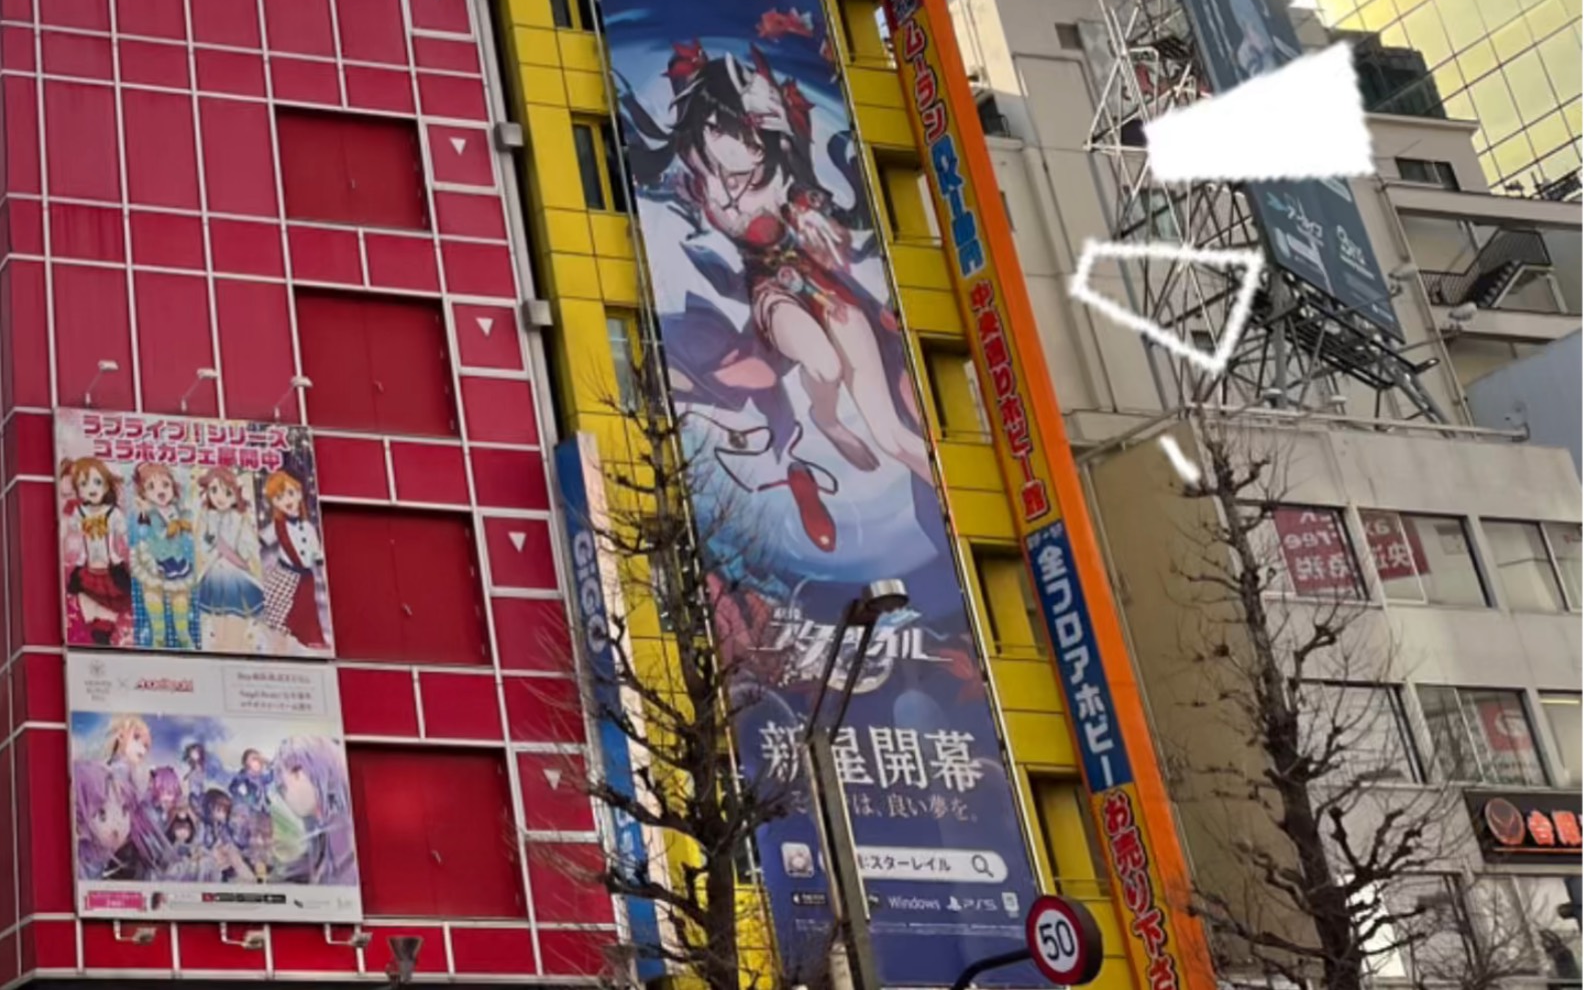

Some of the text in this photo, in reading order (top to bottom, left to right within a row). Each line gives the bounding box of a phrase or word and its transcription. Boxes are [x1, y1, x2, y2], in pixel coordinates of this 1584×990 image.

[1037, 544, 1114, 787] 全フロアホビー
[888, 893, 941, 910] Windows
[1039, 919, 1075, 961] 50
